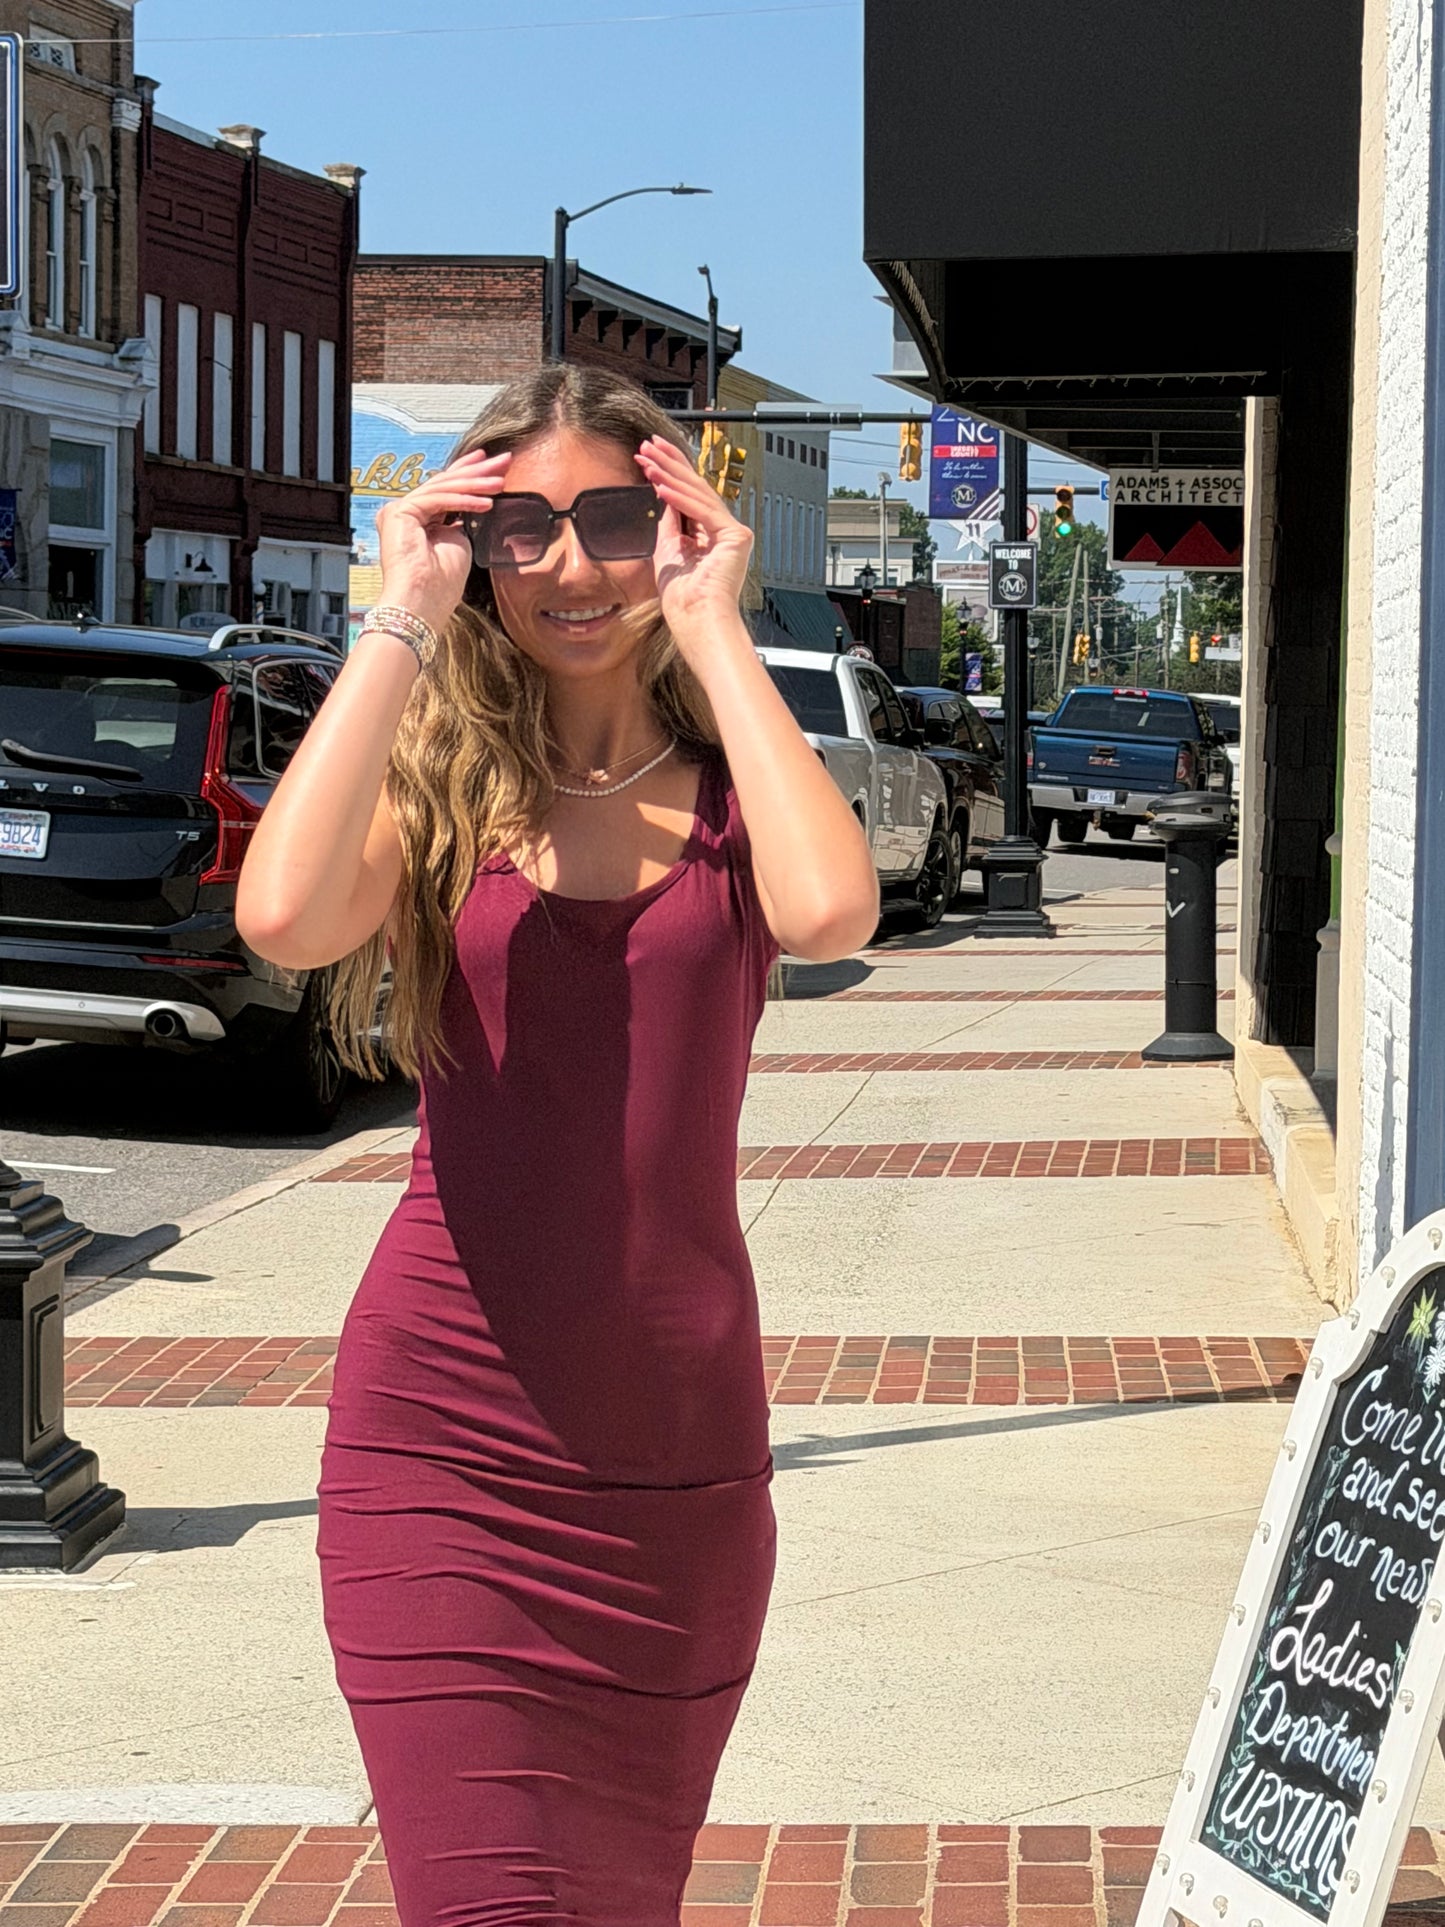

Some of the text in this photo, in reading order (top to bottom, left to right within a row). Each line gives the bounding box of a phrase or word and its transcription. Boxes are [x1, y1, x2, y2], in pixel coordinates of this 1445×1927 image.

[957, 422, 995, 443] NC
[1115, 477, 1170, 489] ADAMS
[1191, 477, 1243, 490] ASSOC
[1115, 490, 1243, 503] ARCHITECT
[966, 523, 981, 537] 11
[995, 549, 1032, 559] WELCOME
[1008, 560, 1018, 570] TO
[176, 830, 200, 841] T5
[1341, 1364, 1422, 1455] Come
[1342, 1457, 1445, 1542] and see
[1315, 1521, 1376, 1567] our
[1269, 1578, 1391, 1709] Ladies
[1246, 1680, 1384, 1796] Departmen
[1220, 1760, 1360, 1897] UPSTAIRS
